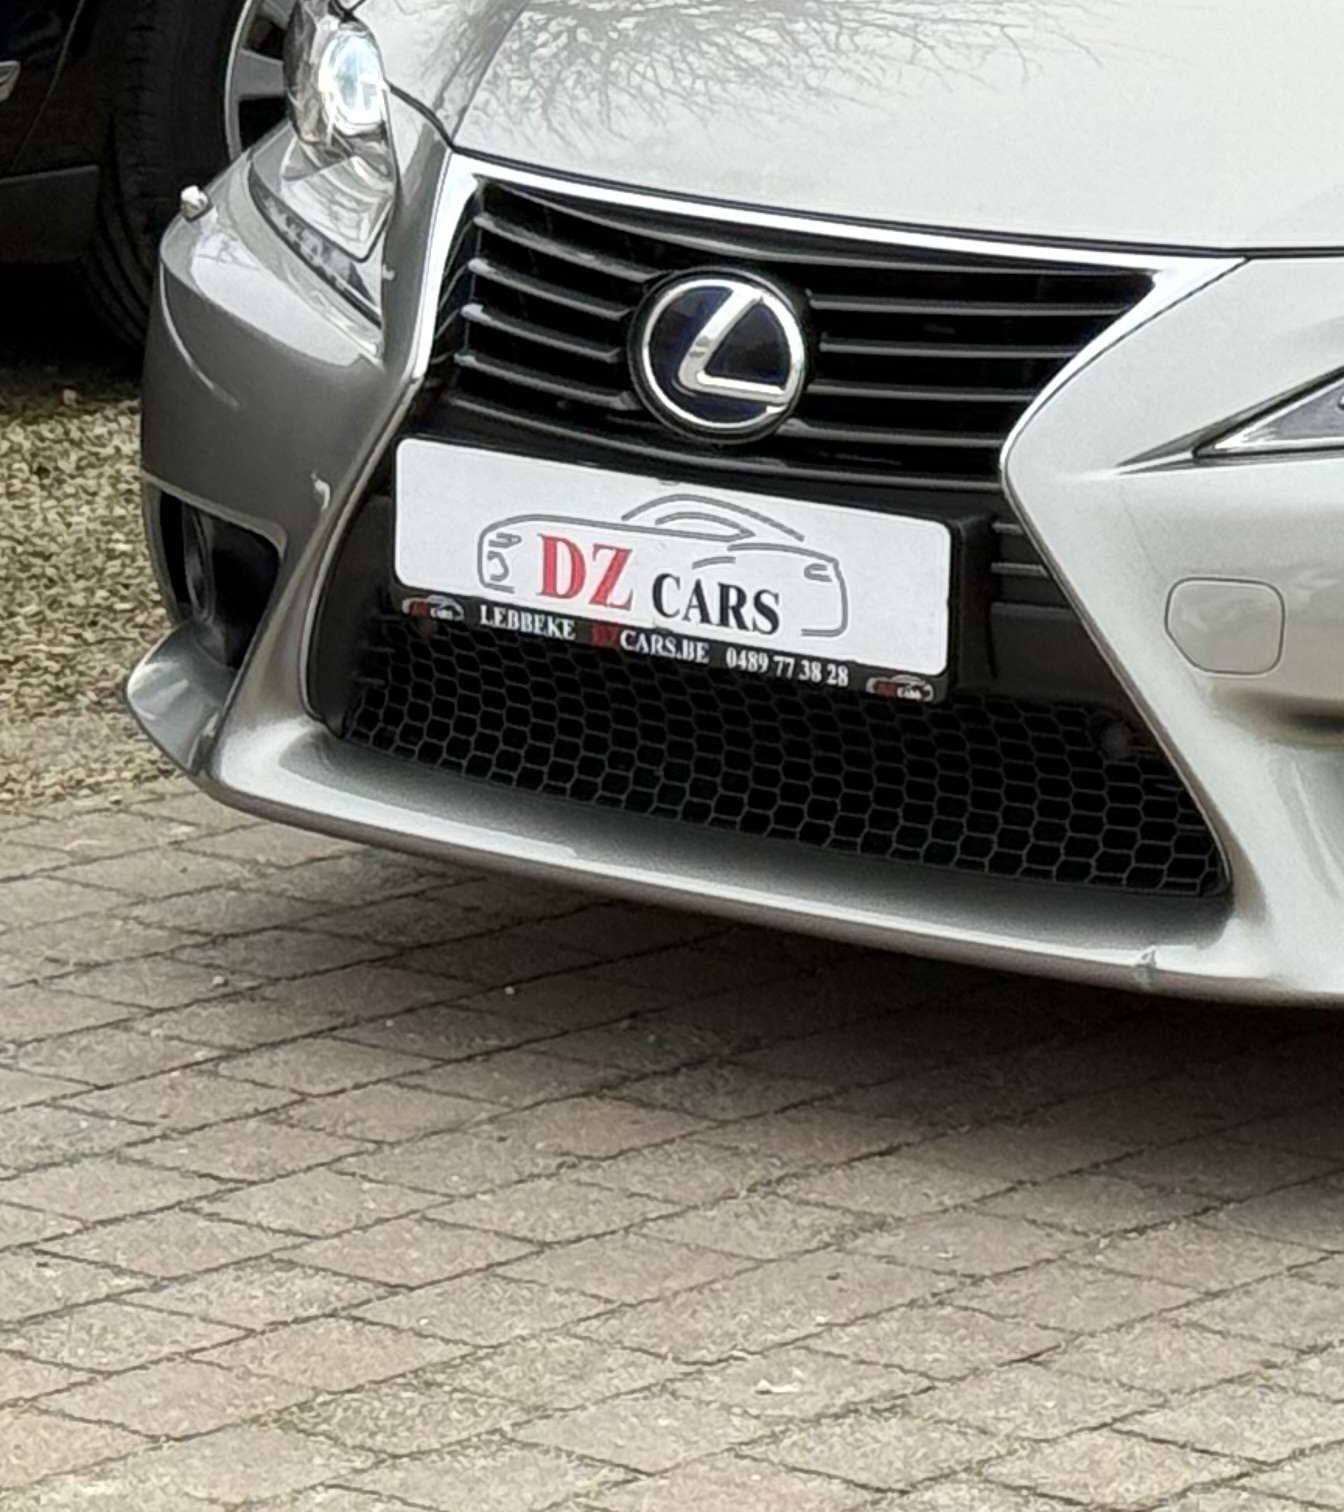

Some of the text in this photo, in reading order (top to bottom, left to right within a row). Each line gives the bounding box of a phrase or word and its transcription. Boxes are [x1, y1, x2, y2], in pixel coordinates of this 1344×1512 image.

[536, 532, 781, 636] DZ CARS
[479, 603, 577, 643] LEBBEKE
[725, 645, 770, 675] 0489
[773, 654, 798, 678] 77
[795, 658, 822, 683] 38
[822, 662, 851, 688] 28
